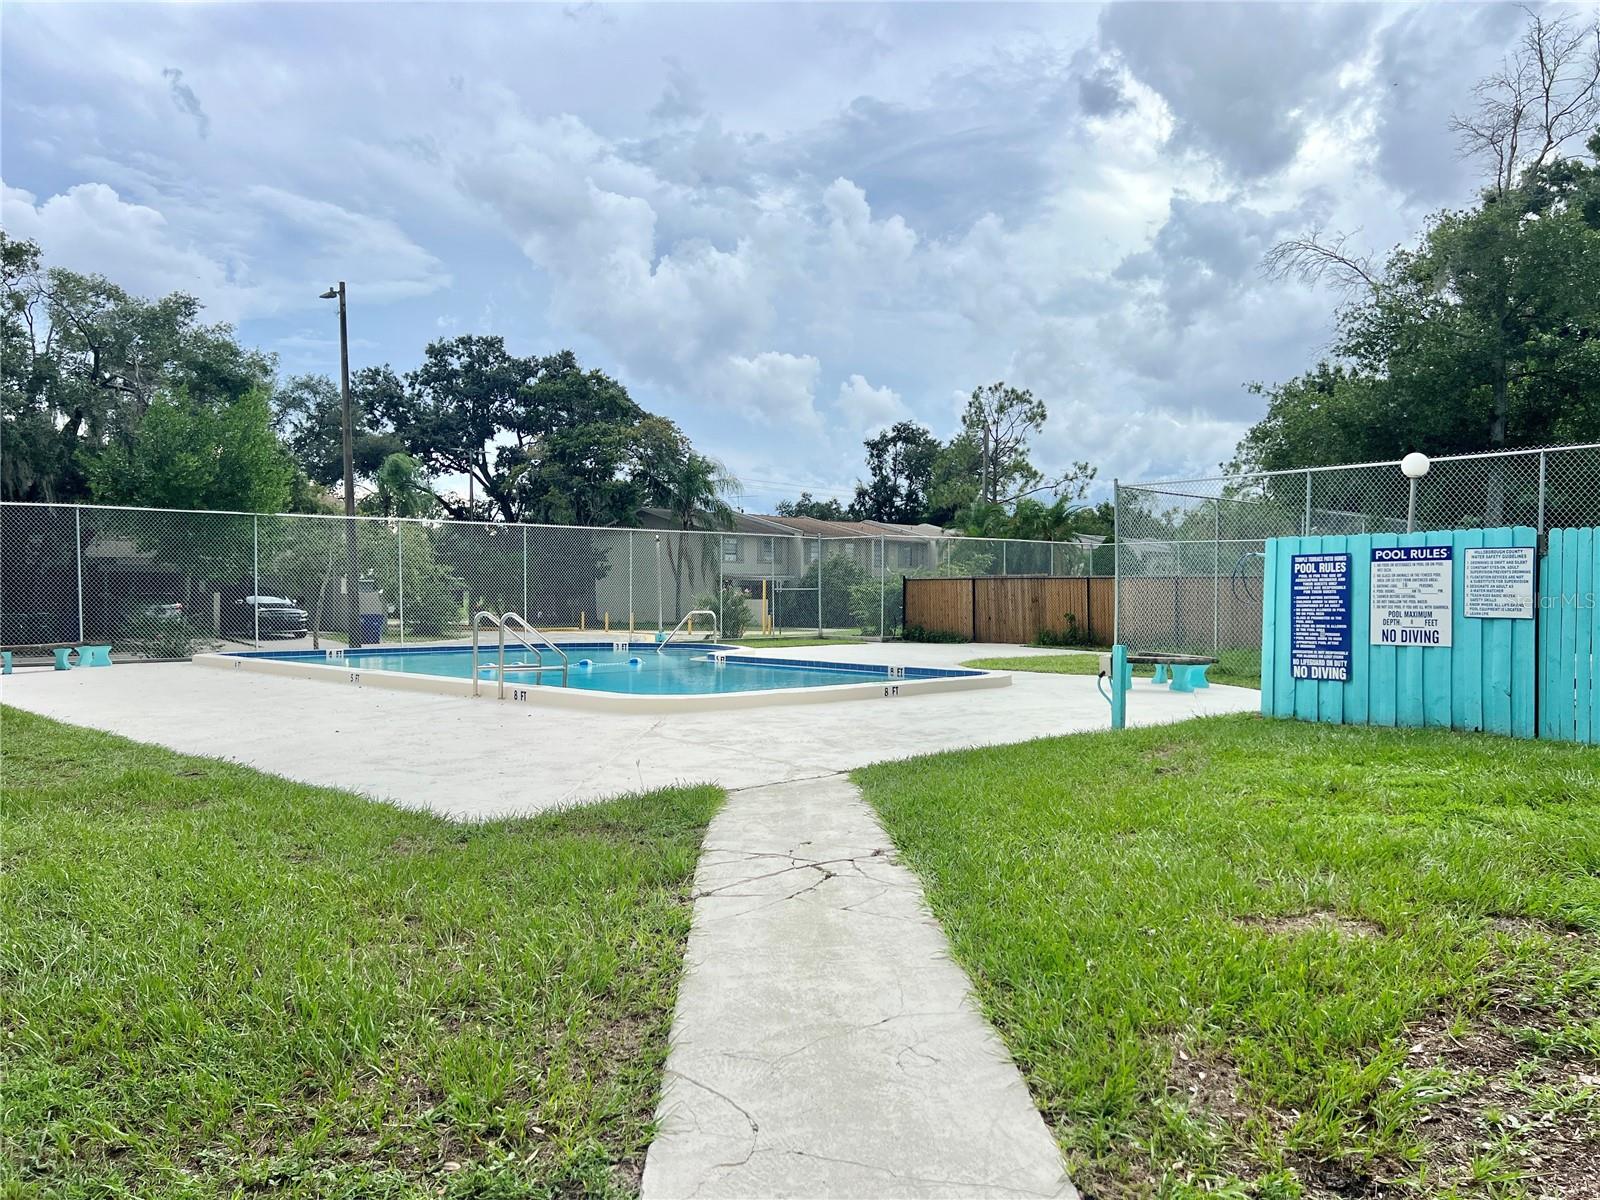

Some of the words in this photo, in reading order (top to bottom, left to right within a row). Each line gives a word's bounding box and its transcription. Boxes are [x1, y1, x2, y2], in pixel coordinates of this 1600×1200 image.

[1376, 550, 1407, 559] POOL
[1410, 549, 1447, 558] RULES
[1295, 563, 1316, 573] POOL
[1319, 562, 1346, 573] RULES
[1382, 629, 1396, 642] NO
[1401, 630, 1439, 644] DIVING
[1294, 666, 1308, 678] NO
[1312, 666, 1346, 680] DIVING
[514, 690, 518, 700] 8
[520, 690, 526, 702] FT
[884, 687, 888, 696] 8
[892, 686, 898, 696] FT
